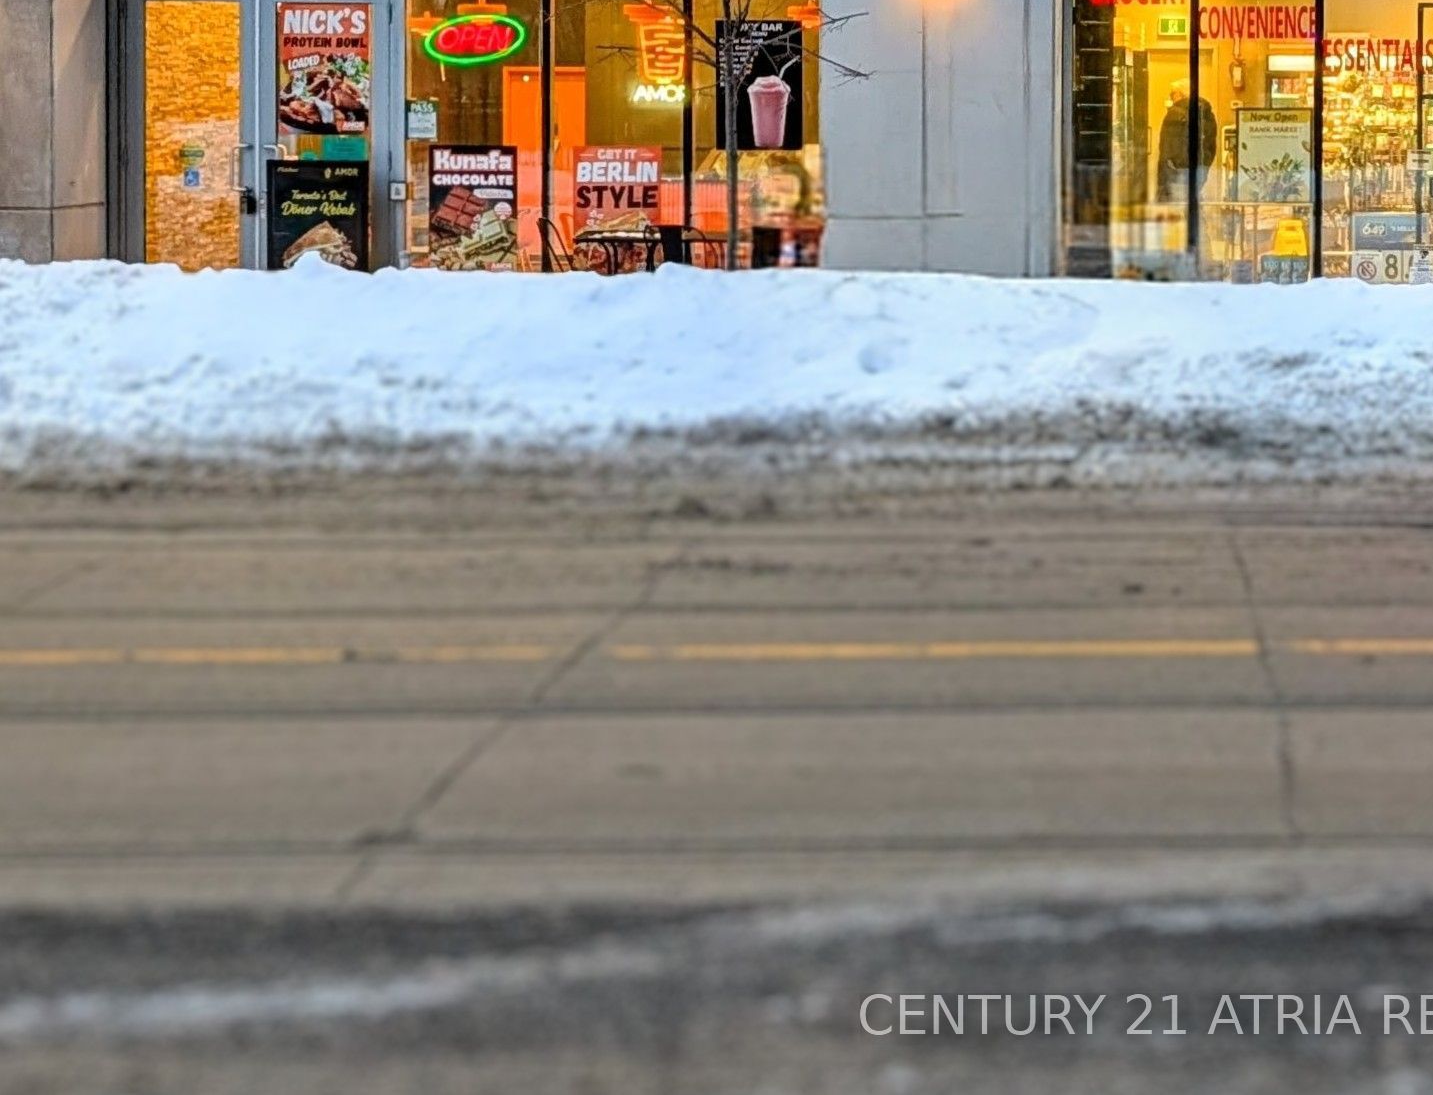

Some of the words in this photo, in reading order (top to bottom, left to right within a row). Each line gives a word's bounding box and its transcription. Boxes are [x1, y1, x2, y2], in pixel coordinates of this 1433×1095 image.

[282, 7, 366, 35] NICK'S
[761, 23, 783, 32] BAR
[1199, 5, 1316, 39] CONVENIENCE
[283, 36, 332, 48] PROTEIN
[335, 36, 368, 48] BOWL
[437, 23, 512, 52] OPEN
[287, 54, 320, 71] LOADED
[1274, 112, 1299, 123] Open
[432, 148, 514, 172] Kunafa
[597, 149, 621, 160] GET
[624, 149, 638, 160] IT
[334, 168, 358, 176] AMOR
[432, 174, 514, 185] CHOCOLATE
[576, 161, 658, 183] BERLIN
[576, 186, 658, 209] STYLE
[1385, 254, 1398, 280] 8
